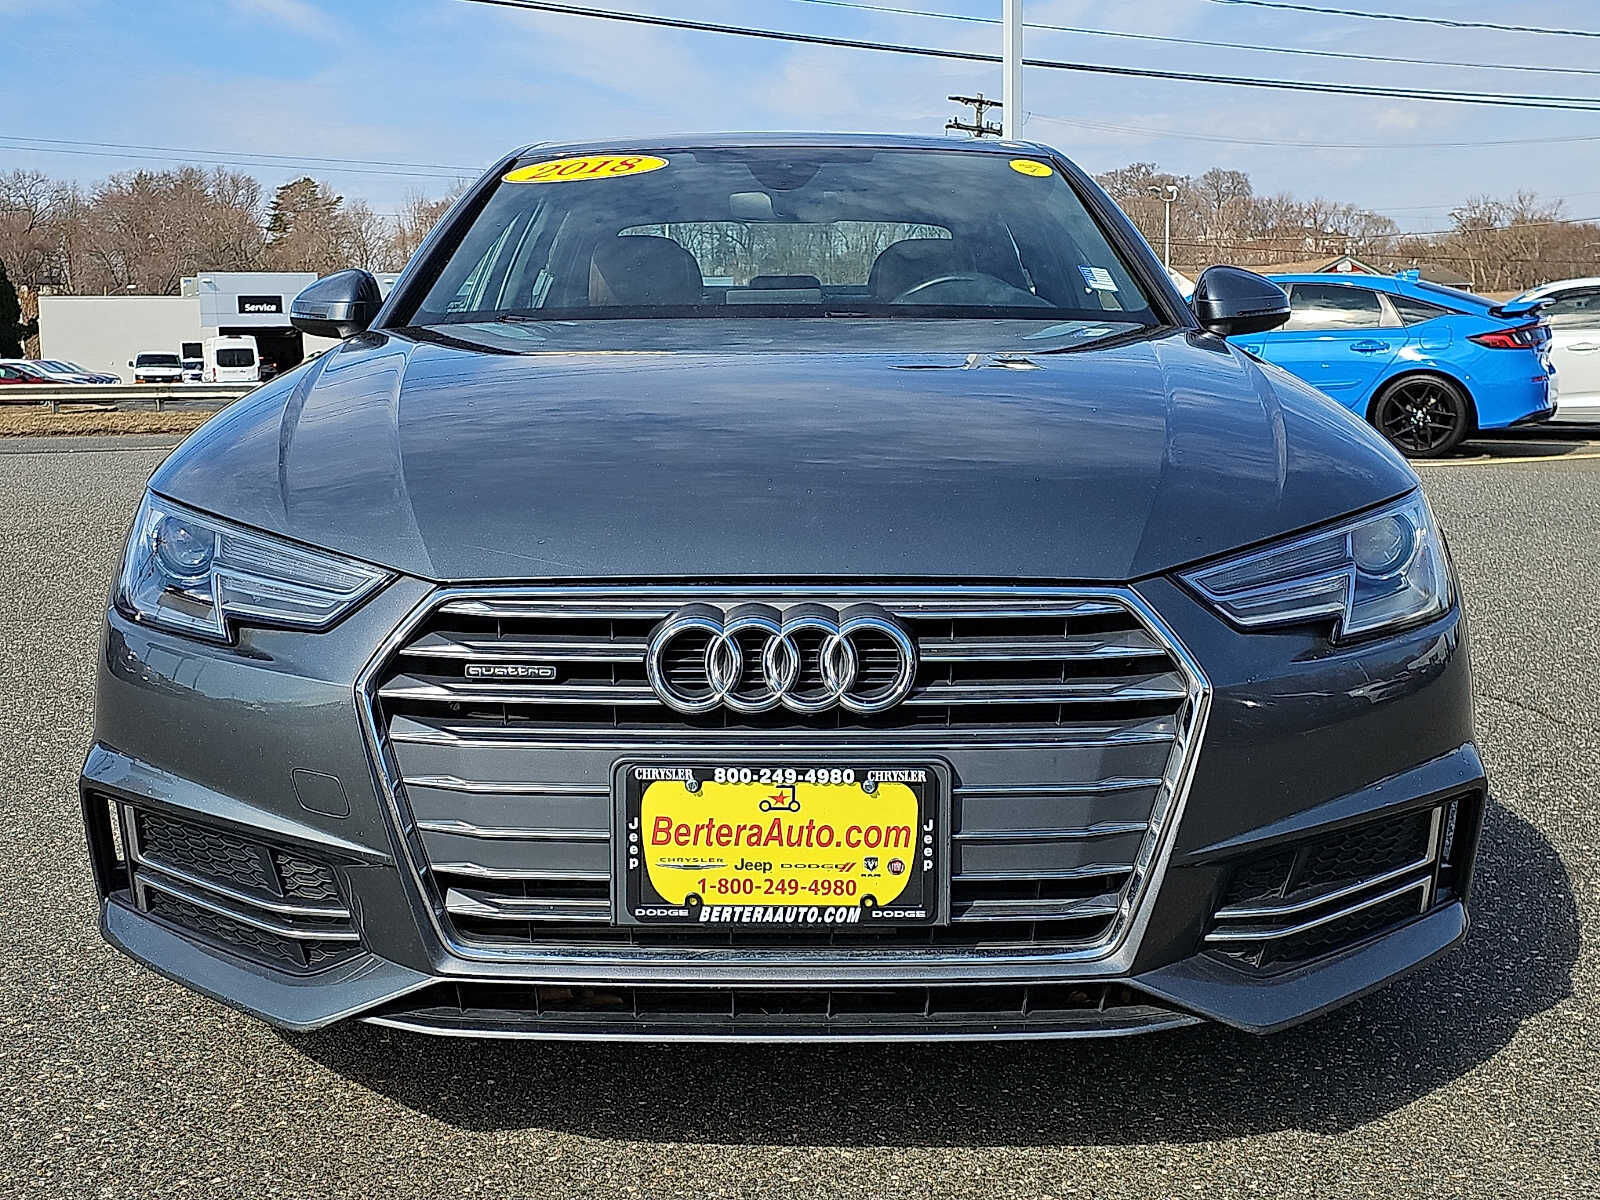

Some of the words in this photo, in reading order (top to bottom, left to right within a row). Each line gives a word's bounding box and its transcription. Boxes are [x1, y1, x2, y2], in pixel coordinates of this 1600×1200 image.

[527, 158, 643, 180] 2018
[244, 303, 277, 312] Service
[468, 667, 552, 678] quattro
[634, 768, 694, 780] CHRYSLER
[714, 768, 855, 784] 800-249-4980
[867, 770, 927, 782] CHRYSLER
[651, 816, 911, 848] BerteraAuto.com
[628, 817, 639, 870] Jeep
[923, 819, 934, 872] Jeep
[734, 858, 773, 873] Jeep
[697, 878, 857, 896] 1-800-249-4980
[699, 906, 861, 923] BERTERAAUTO.COM
[872, 910, 926, 918] DODGE
